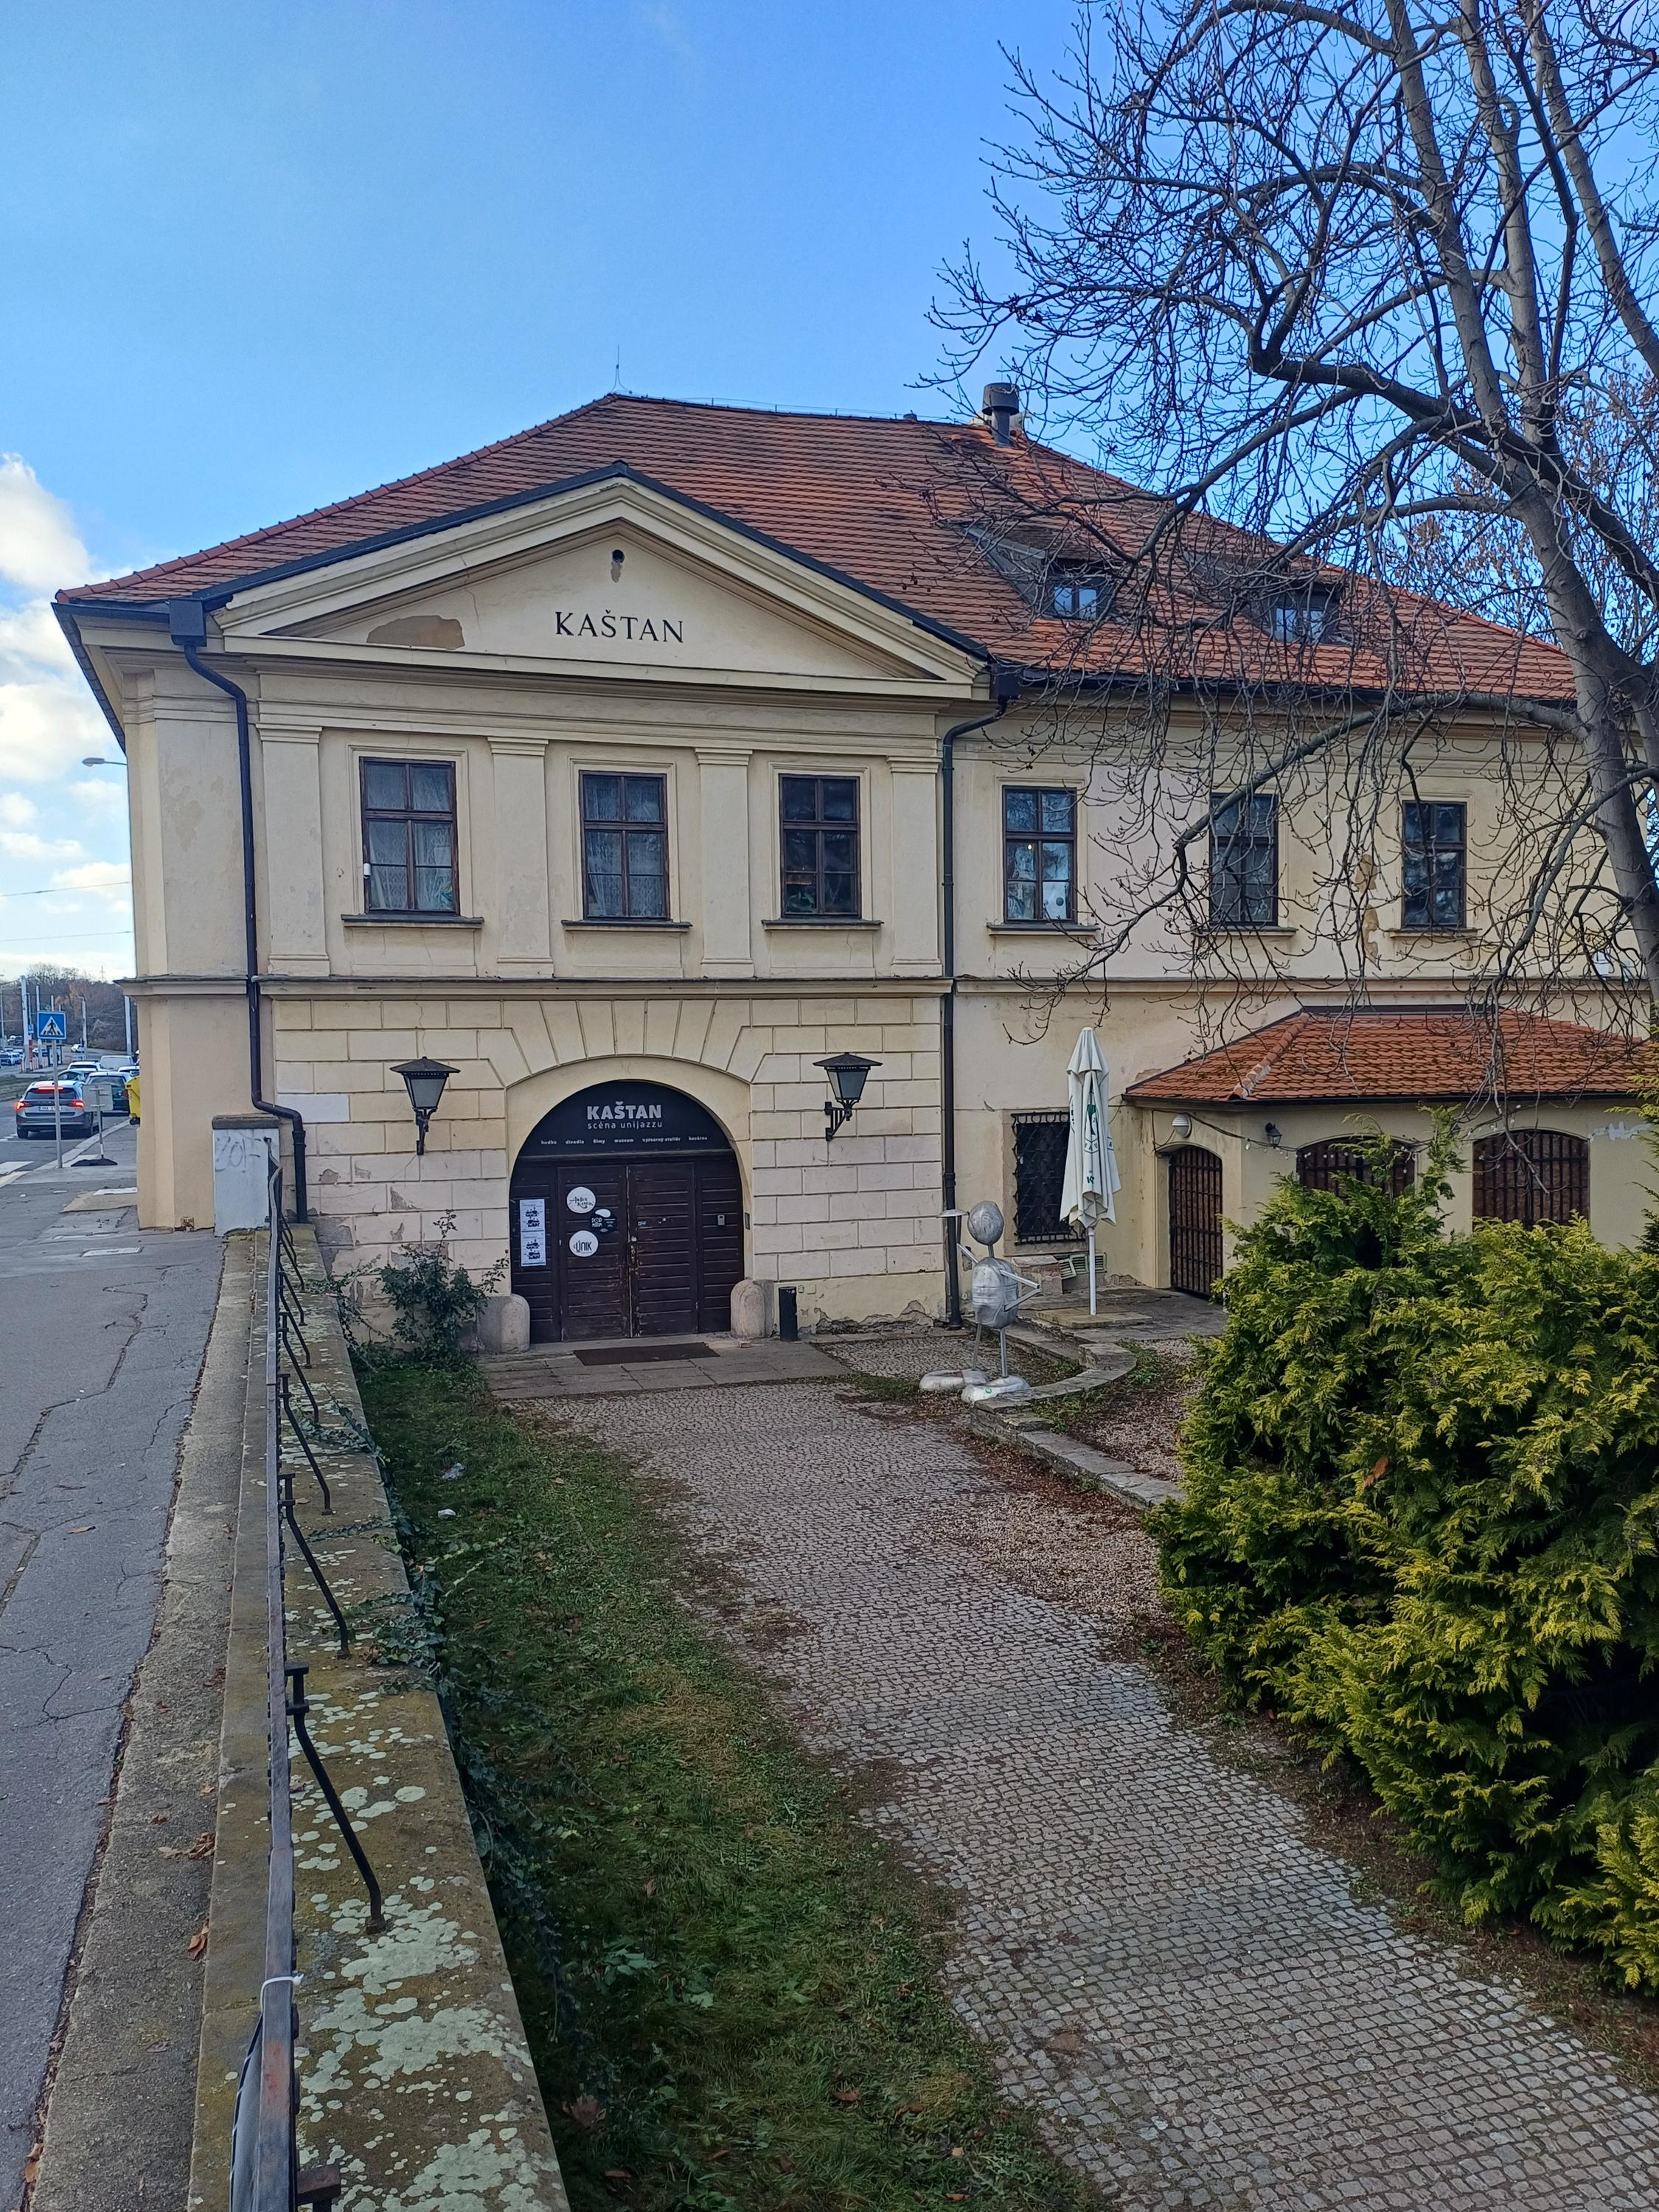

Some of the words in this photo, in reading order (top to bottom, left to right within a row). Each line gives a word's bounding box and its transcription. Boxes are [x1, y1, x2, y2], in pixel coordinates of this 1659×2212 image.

[555, 609, 684, 643] KAŠTAN
[587, 1101, 661, 1120] KAŠTAN
[588, 1121, 616, 1130] scéna
[620, 1121, 663, 1130] unijazzu
